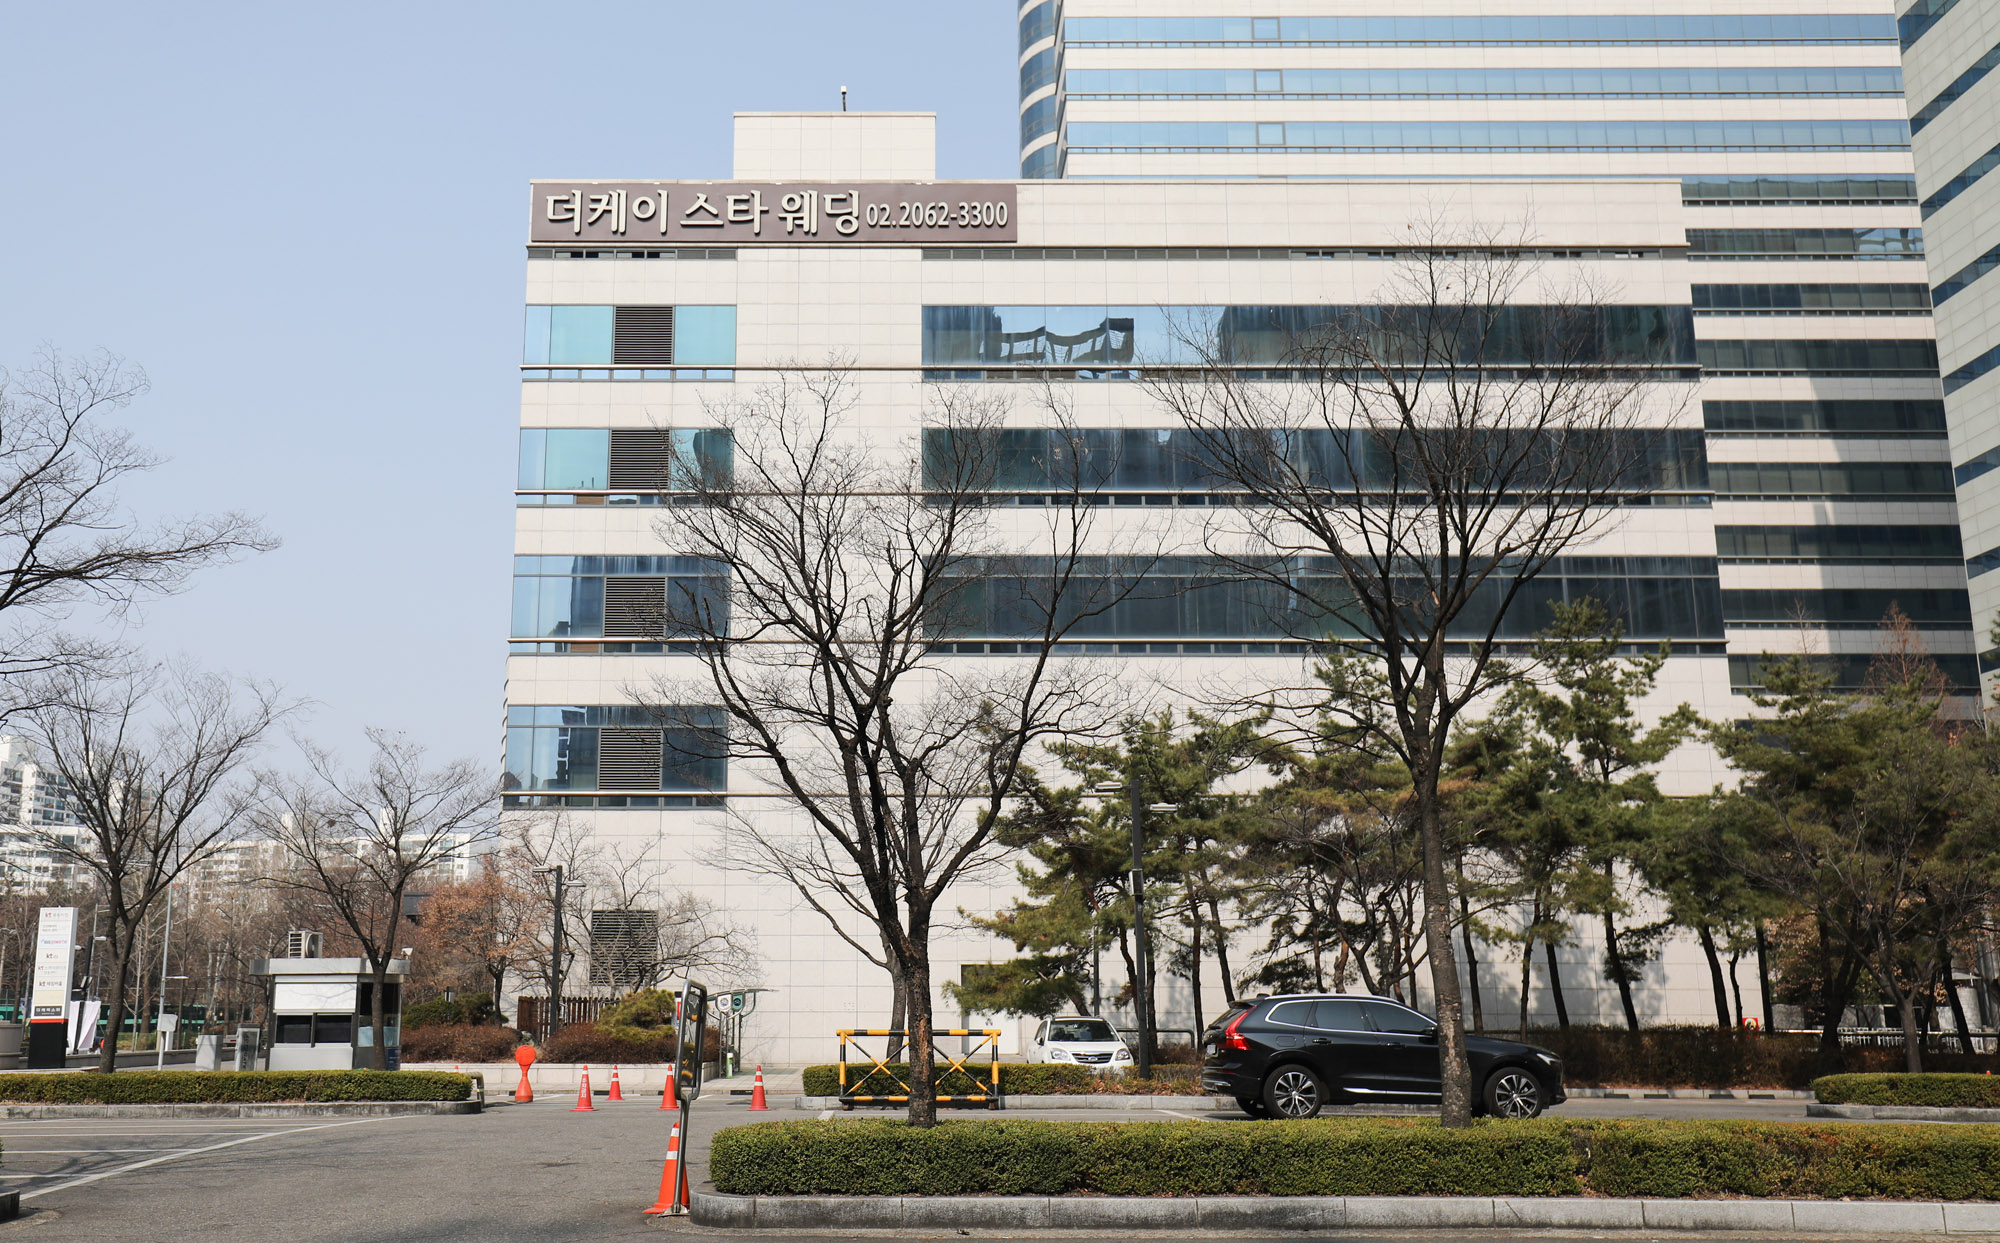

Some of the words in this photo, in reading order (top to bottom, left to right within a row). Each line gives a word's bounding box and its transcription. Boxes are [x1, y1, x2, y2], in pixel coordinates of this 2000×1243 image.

[546, 189, 668, 234] 더케이
[680, 189, 769, 234] 스타
[778, 189, 860, 234] 웨딩
[866, 201, 1008, 227] 02.2062-3300
